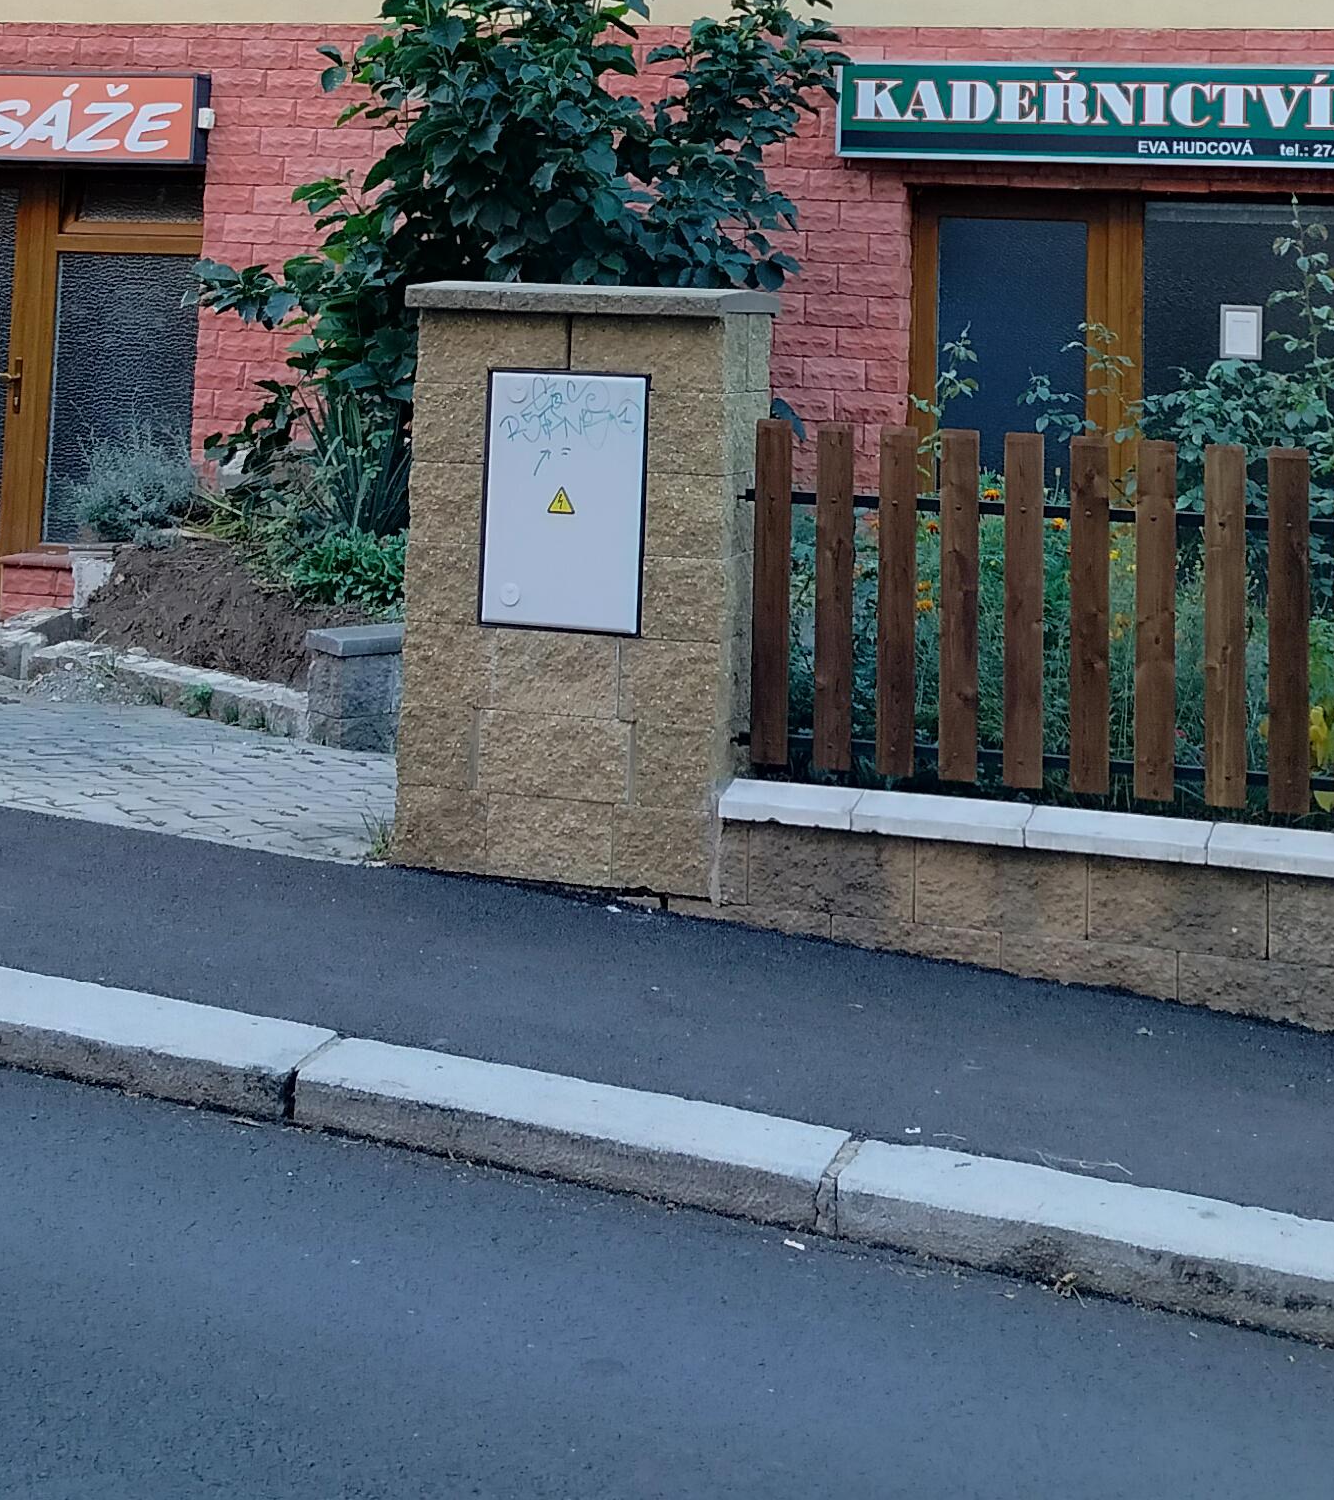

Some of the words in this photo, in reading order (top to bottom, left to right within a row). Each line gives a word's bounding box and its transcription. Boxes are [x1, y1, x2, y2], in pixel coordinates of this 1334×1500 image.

[1137, 140, 1169, 154] EVA
[1172, 139, 1254, 156] HUDCOVÁ
[1279, 143, 1310, 157] tel.:
